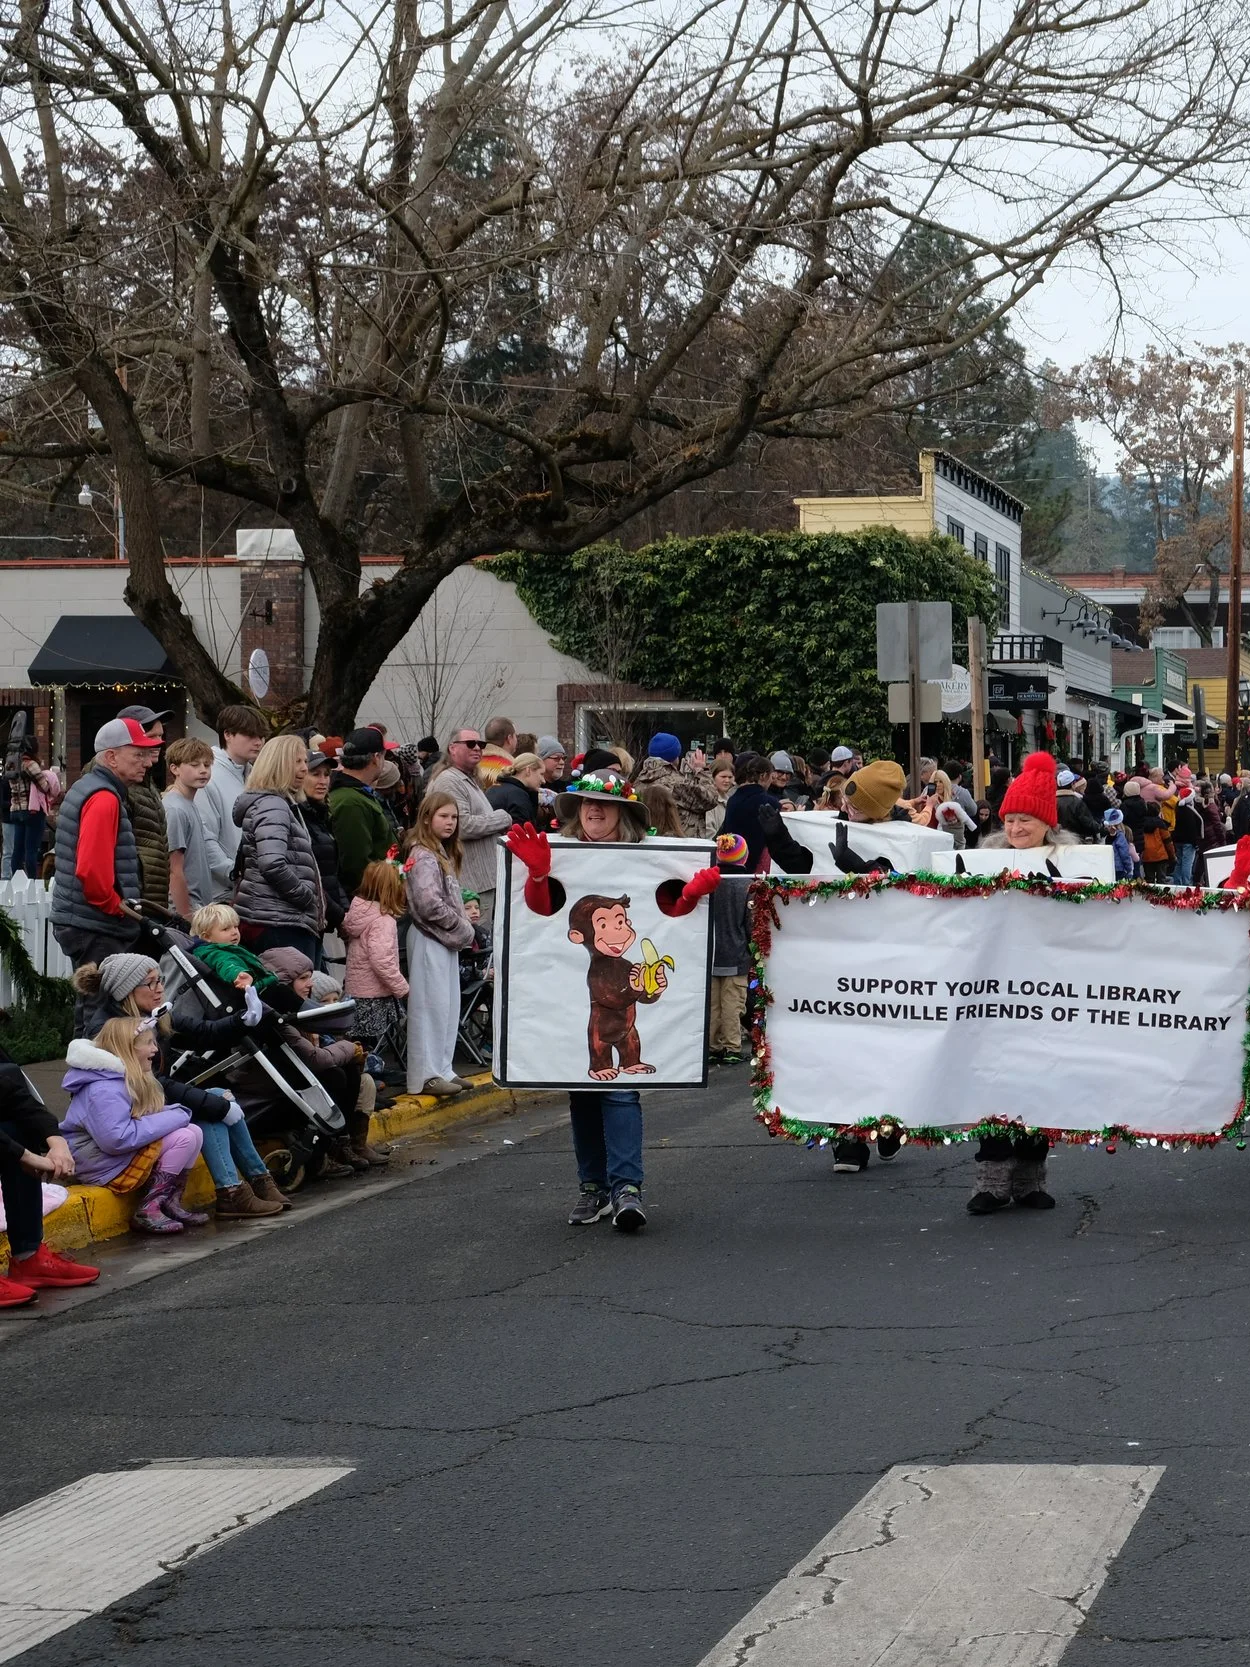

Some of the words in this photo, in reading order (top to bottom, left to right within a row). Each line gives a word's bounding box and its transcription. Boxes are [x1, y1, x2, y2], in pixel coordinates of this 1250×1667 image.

[939, 682, 969, 691] AKERY
[836, 976, 938, 997] SUPPORT
[945, 979, 999, 998] YOUR
[1007, 980, 1079, 999] LOCAL
[1087, 984, 1182, 1005] LIBRARY
[788, 998, 948, 1022] JACKSONVILLE
[956, 1003, 1044, 1022] FRIENDS
[1051, 1007, 1079, 1023] OF
[1088, 1009, 1131, 1026] THE
[1138, 1011, 1232, 1031] LIBRARY
